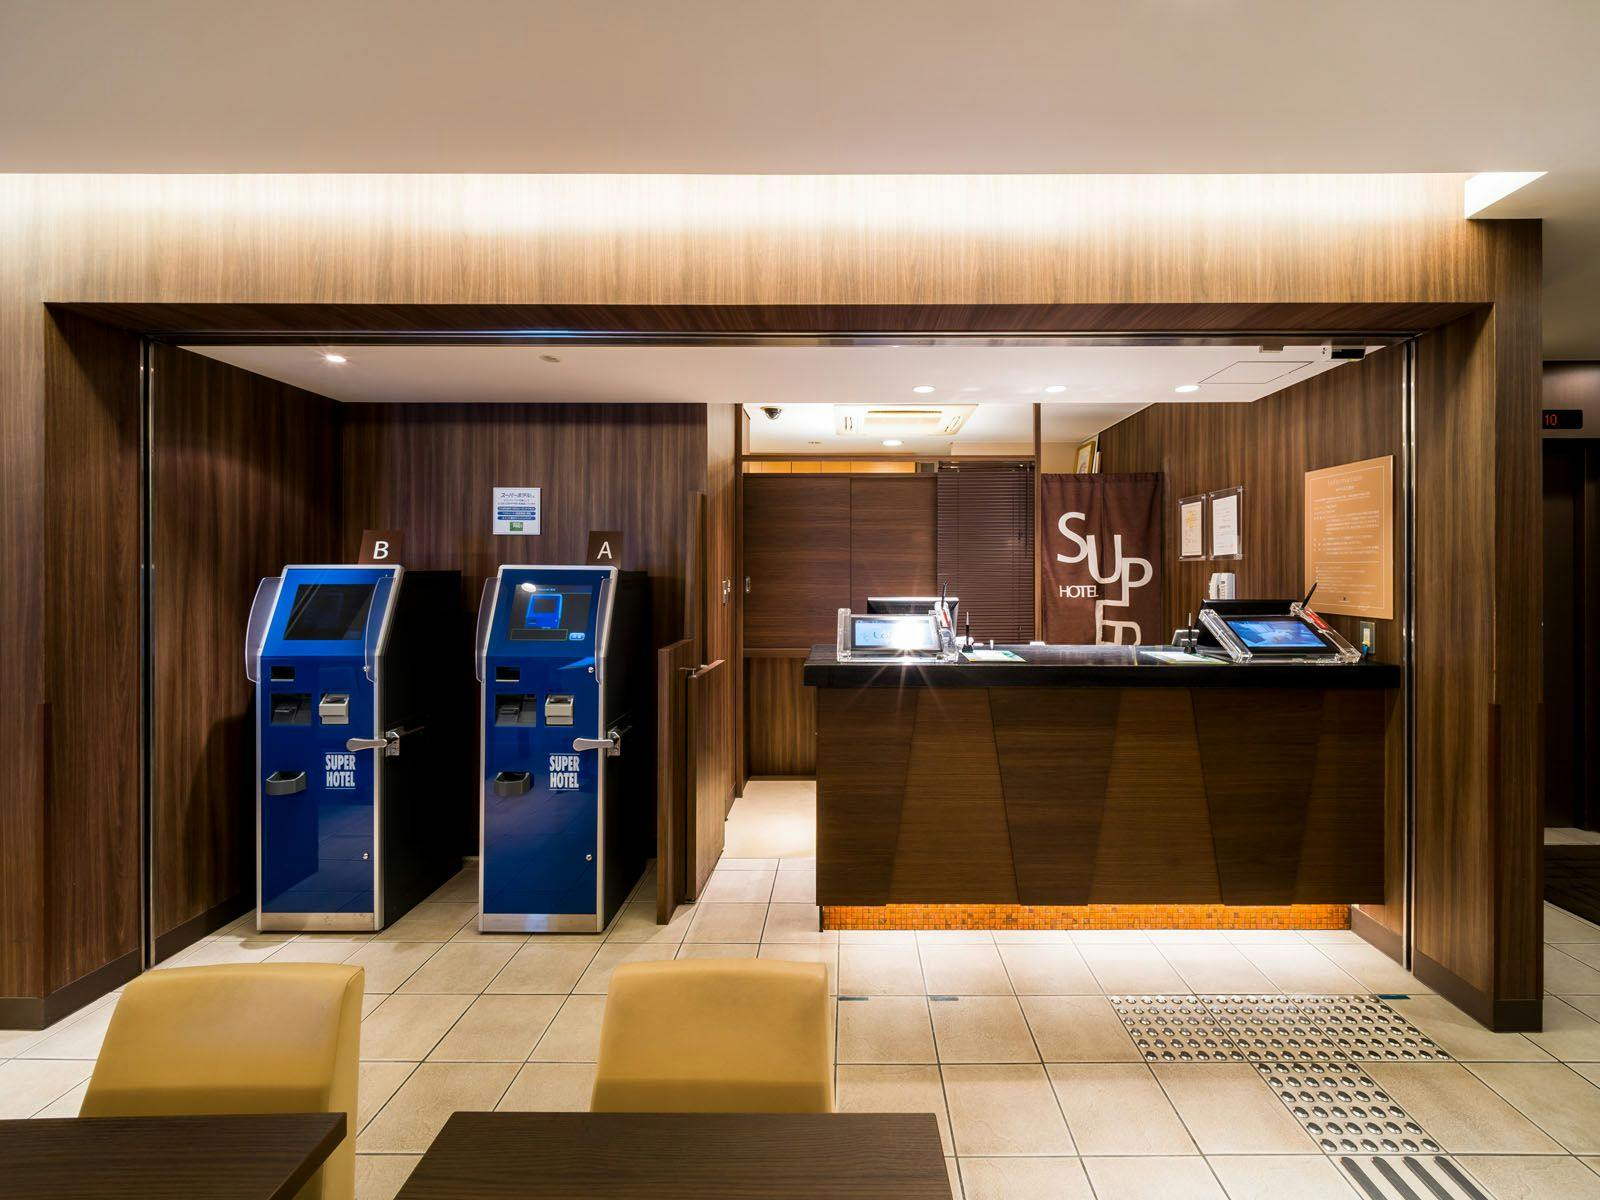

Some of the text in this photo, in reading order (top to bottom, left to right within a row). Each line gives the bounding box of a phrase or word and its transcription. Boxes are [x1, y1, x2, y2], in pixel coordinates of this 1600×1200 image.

[1545, 414, 1557, 426] 10
[373, 541, 389, 560] B
[597, 541, 613, 560] A
[1059, 585, 1099, 598] HOTEL
[325, 754, 356, 770] SUPER
[549, 755, 580, 771] SUPER
[326, 771, 356, 787] HOTEL
[549, 772, 580, 788] HOTEL
